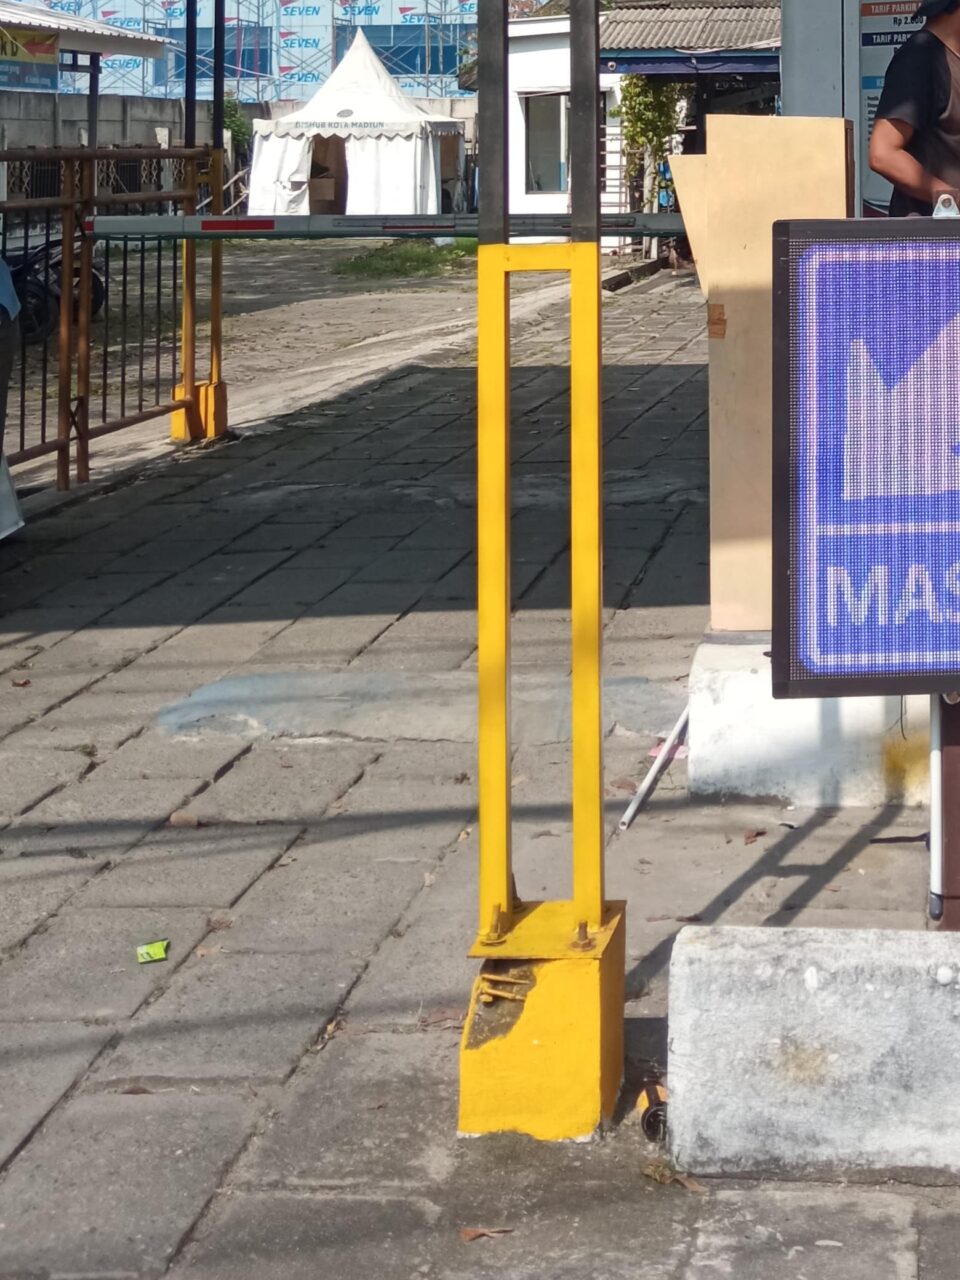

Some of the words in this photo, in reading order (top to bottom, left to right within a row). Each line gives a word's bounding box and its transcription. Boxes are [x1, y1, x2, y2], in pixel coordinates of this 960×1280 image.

[282, 6, 320, 16] SEVEN
[342, 5, 380, 16] SEVEN
[871, 4, 890, 14] TARIF
[893, 16, 902, 26] Rp
[282, 38, 320, 48] SEVEN
[872, 33, 892, 44] TARIF
[103, 57, 141, 68] SEVEN
[282, 71, 320, 82] SEVEN
[328, 121, 349, 129] KOTA
[351, 121, 384, 129] MADIUN
